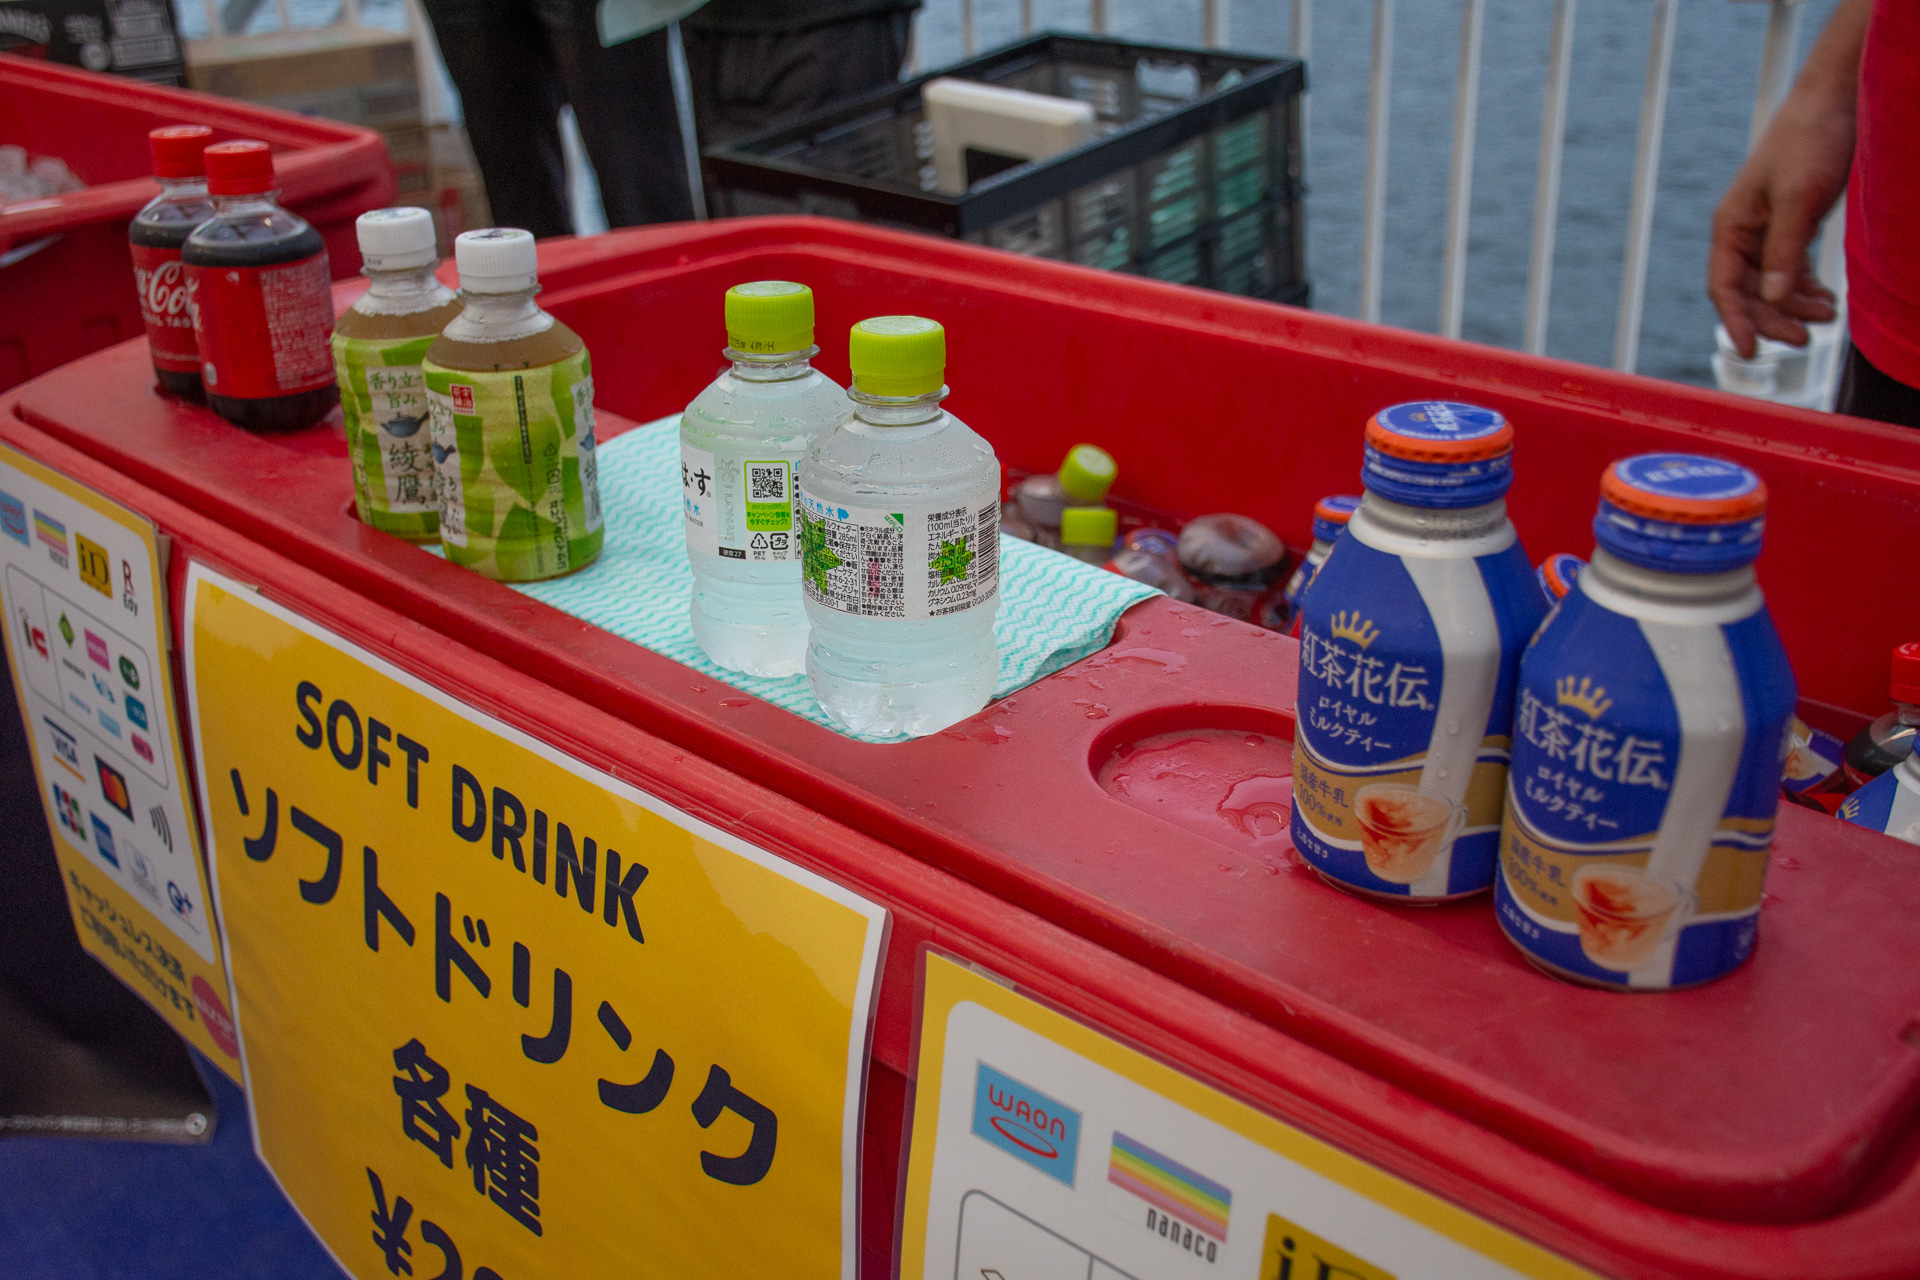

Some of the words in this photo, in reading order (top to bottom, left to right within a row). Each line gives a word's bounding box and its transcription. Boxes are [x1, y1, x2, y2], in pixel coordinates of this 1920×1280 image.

[388, 440, 427, 506] 綾鷹
[927, 506, 967, 522] 栄養成分表示
[80, 543, 109, 586] iD
[1301, 625, 1430, 711] 紅茶花伝
[1309, 706, 1392, 752] ミルクティー
[1318, 696, 1378, 726] ロイヤル
[1517, 687, 1666, 790] 紅茶花伝
[296, 681, 430, 809] SOFT
[451, 764, 649, 944] DRINK
[1299, 762, 1349, 809] 国産牛乳
[1524, 775, 1619, 831] ミルクティー
[1536, 765, 1604, 804] ロイヤル
[230, 768, 778, 1186] ソフトドリンク
[392, 1038, 543, 1238] 各種
[988, 1083, 1066, 1142] WAON
[1146, 1207, 1218, 1265] nanaco
